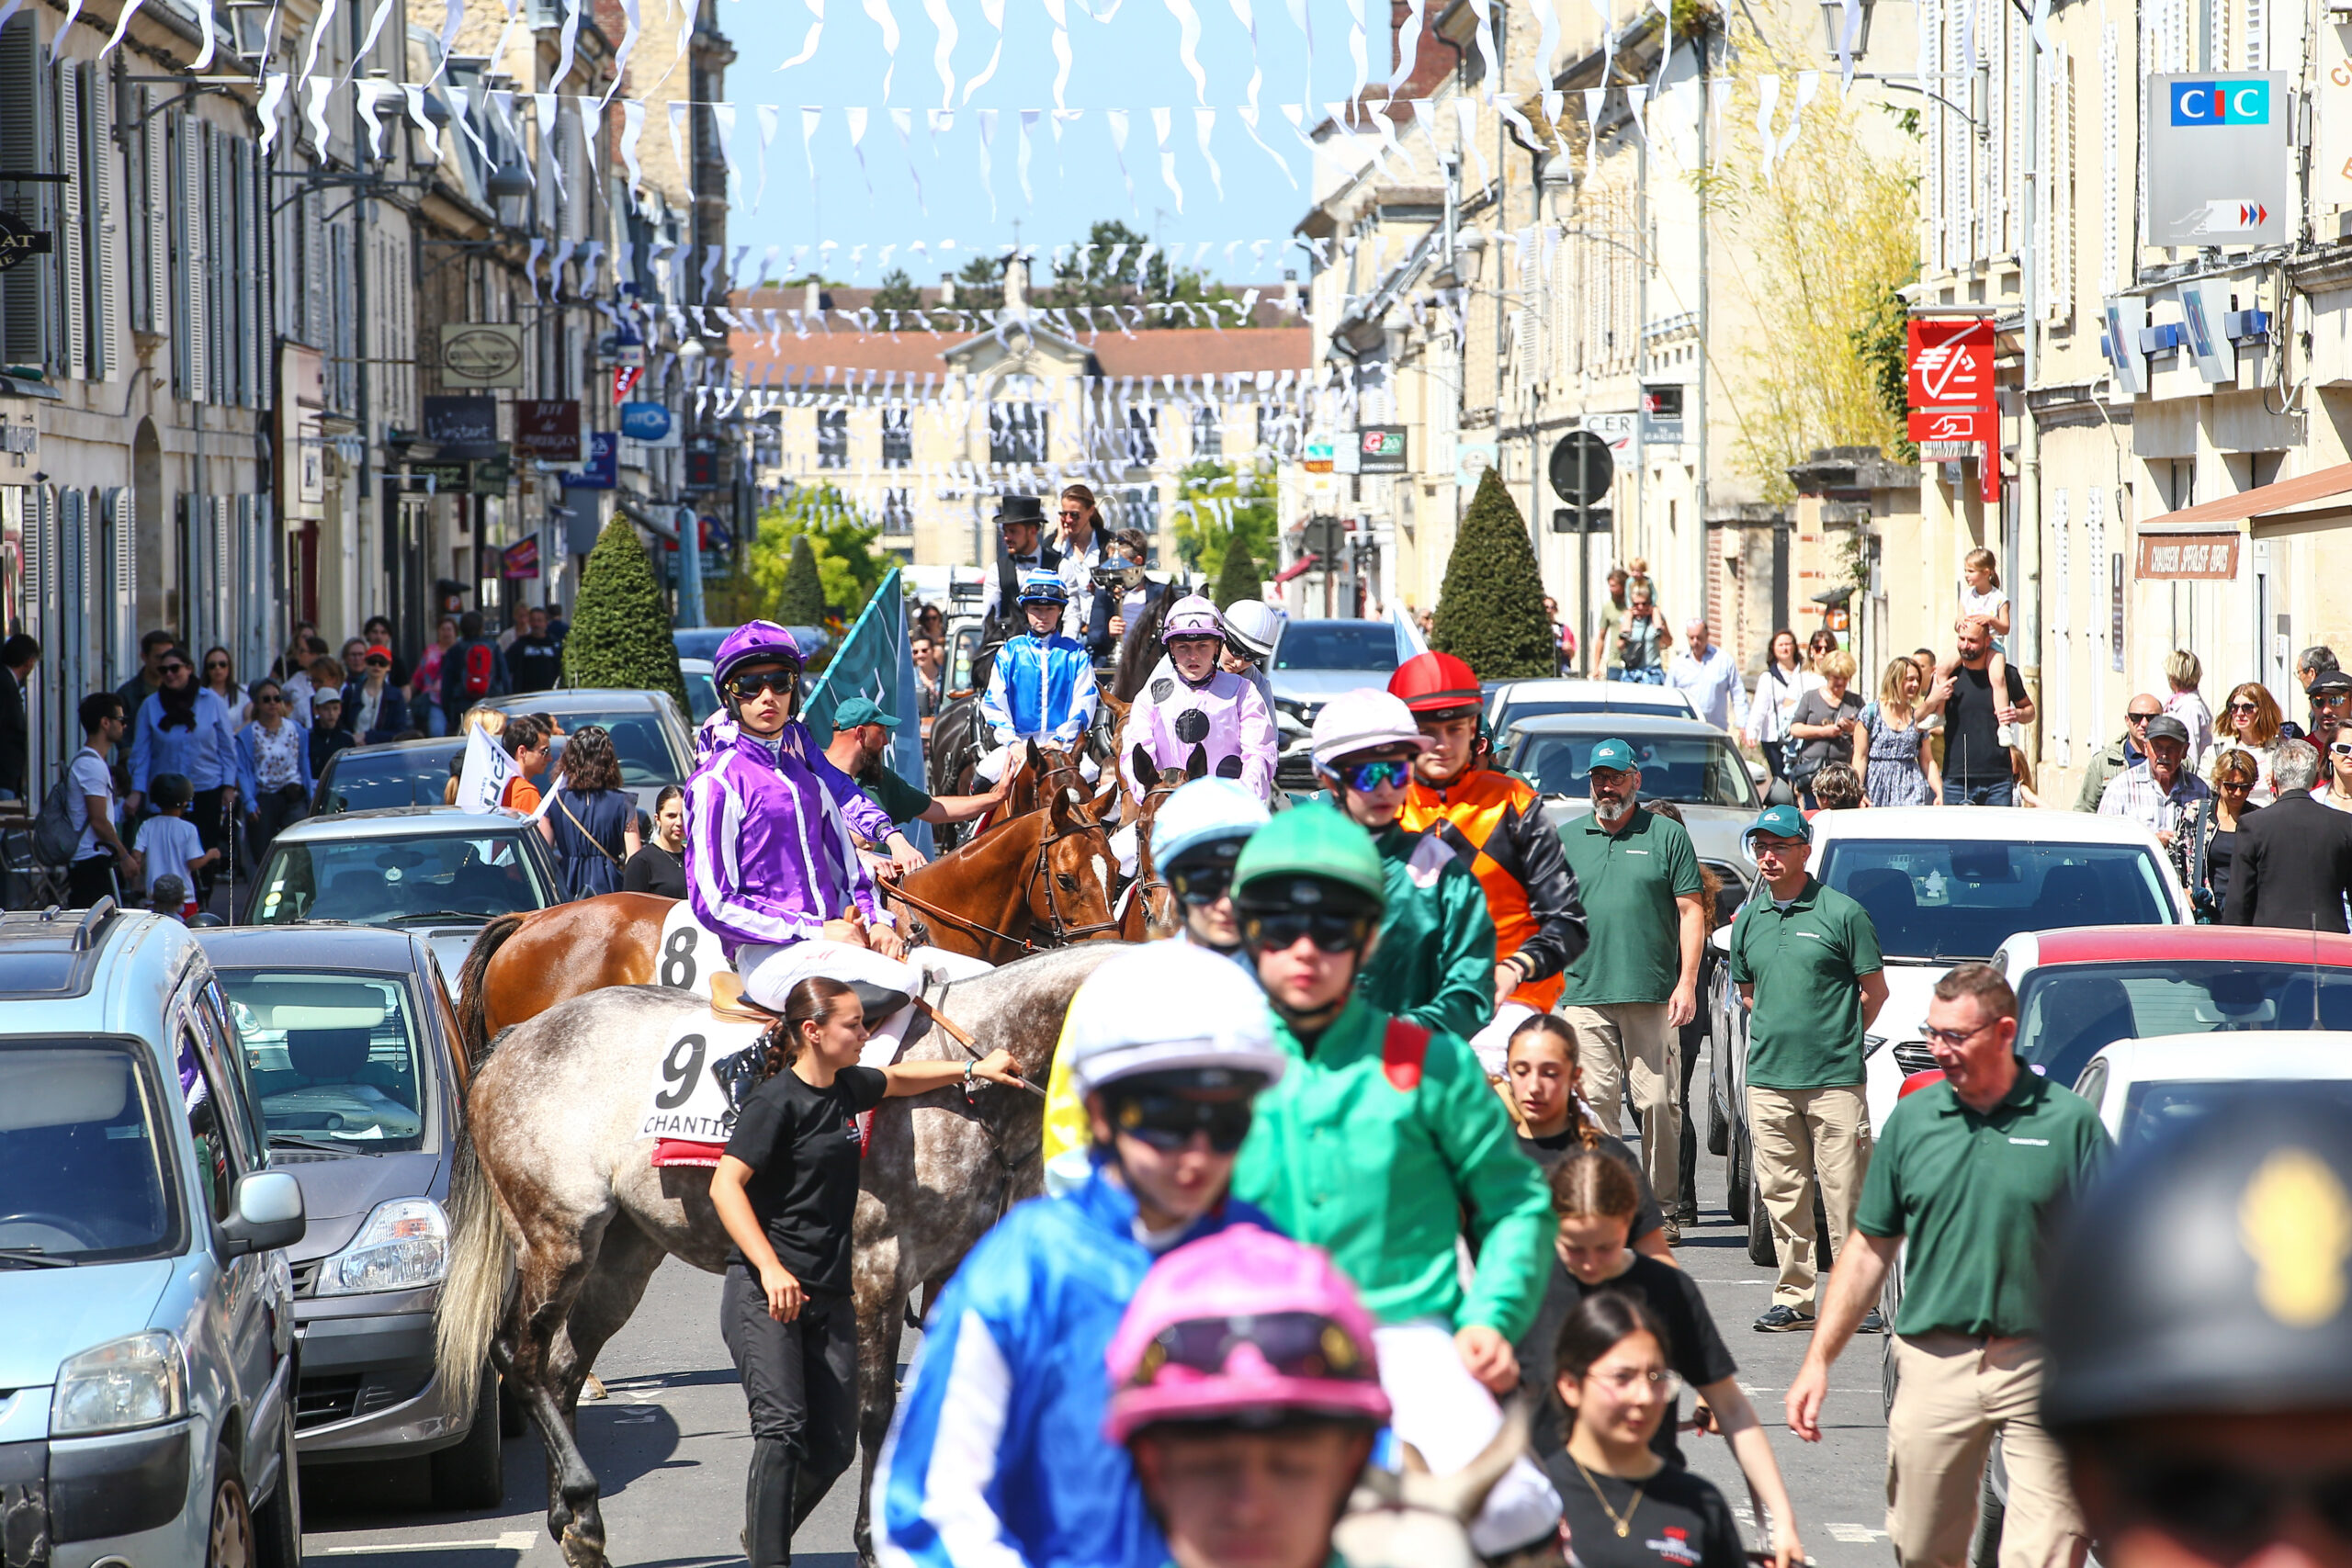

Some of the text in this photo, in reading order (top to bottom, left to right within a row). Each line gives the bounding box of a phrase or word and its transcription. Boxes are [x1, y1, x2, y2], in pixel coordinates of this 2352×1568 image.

[2179, 88, 2259, 118] CIC
[1587, 415, 1631, 432] CER
[1833, 609, 1847, 629] P
[661, 926, 698, 991] 8
[655, 1033, 707, 1110] 9
[644, 1114, 734, 1138] CHANTIL
